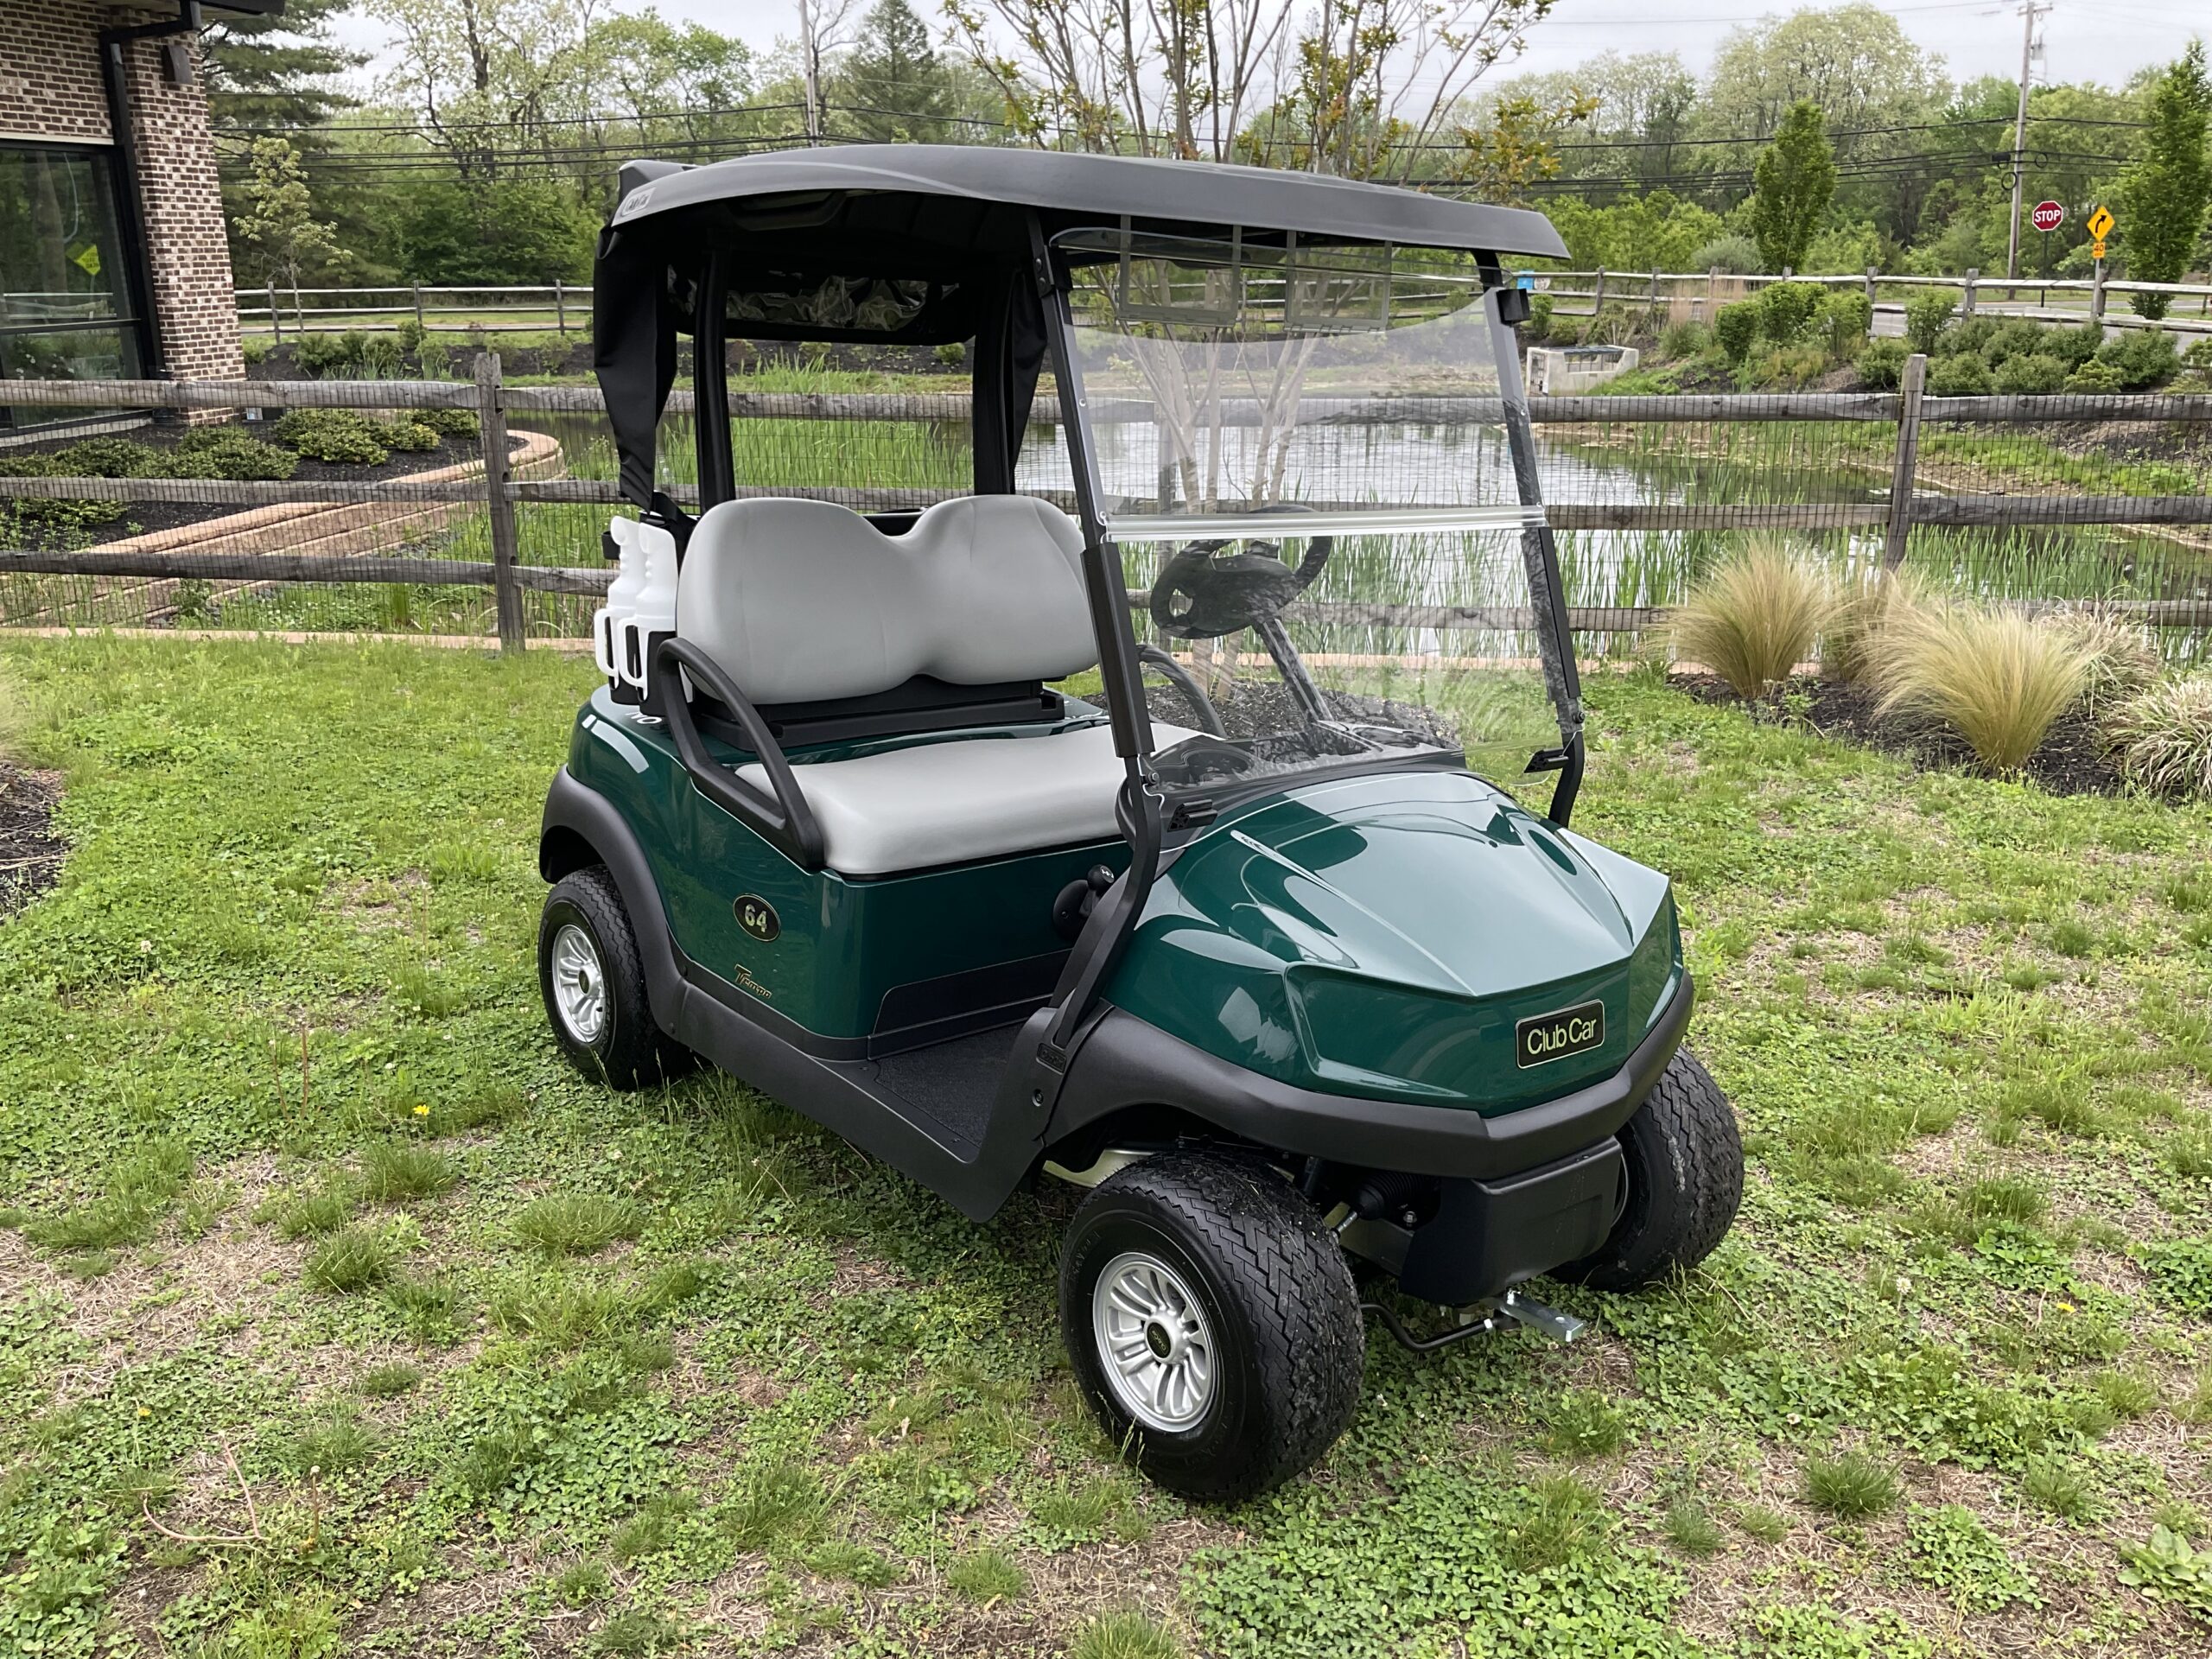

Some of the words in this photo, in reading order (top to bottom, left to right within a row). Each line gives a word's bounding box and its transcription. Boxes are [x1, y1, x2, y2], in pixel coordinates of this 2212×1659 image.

[2034, 209, 2061, 222] STOP
[744, 903, 767, 932] 64
[734, 963, 772, 999] Tempo
[1527, 1024, 1567, 1055] Club
[1568, 1017, 1597, 1044] Car
